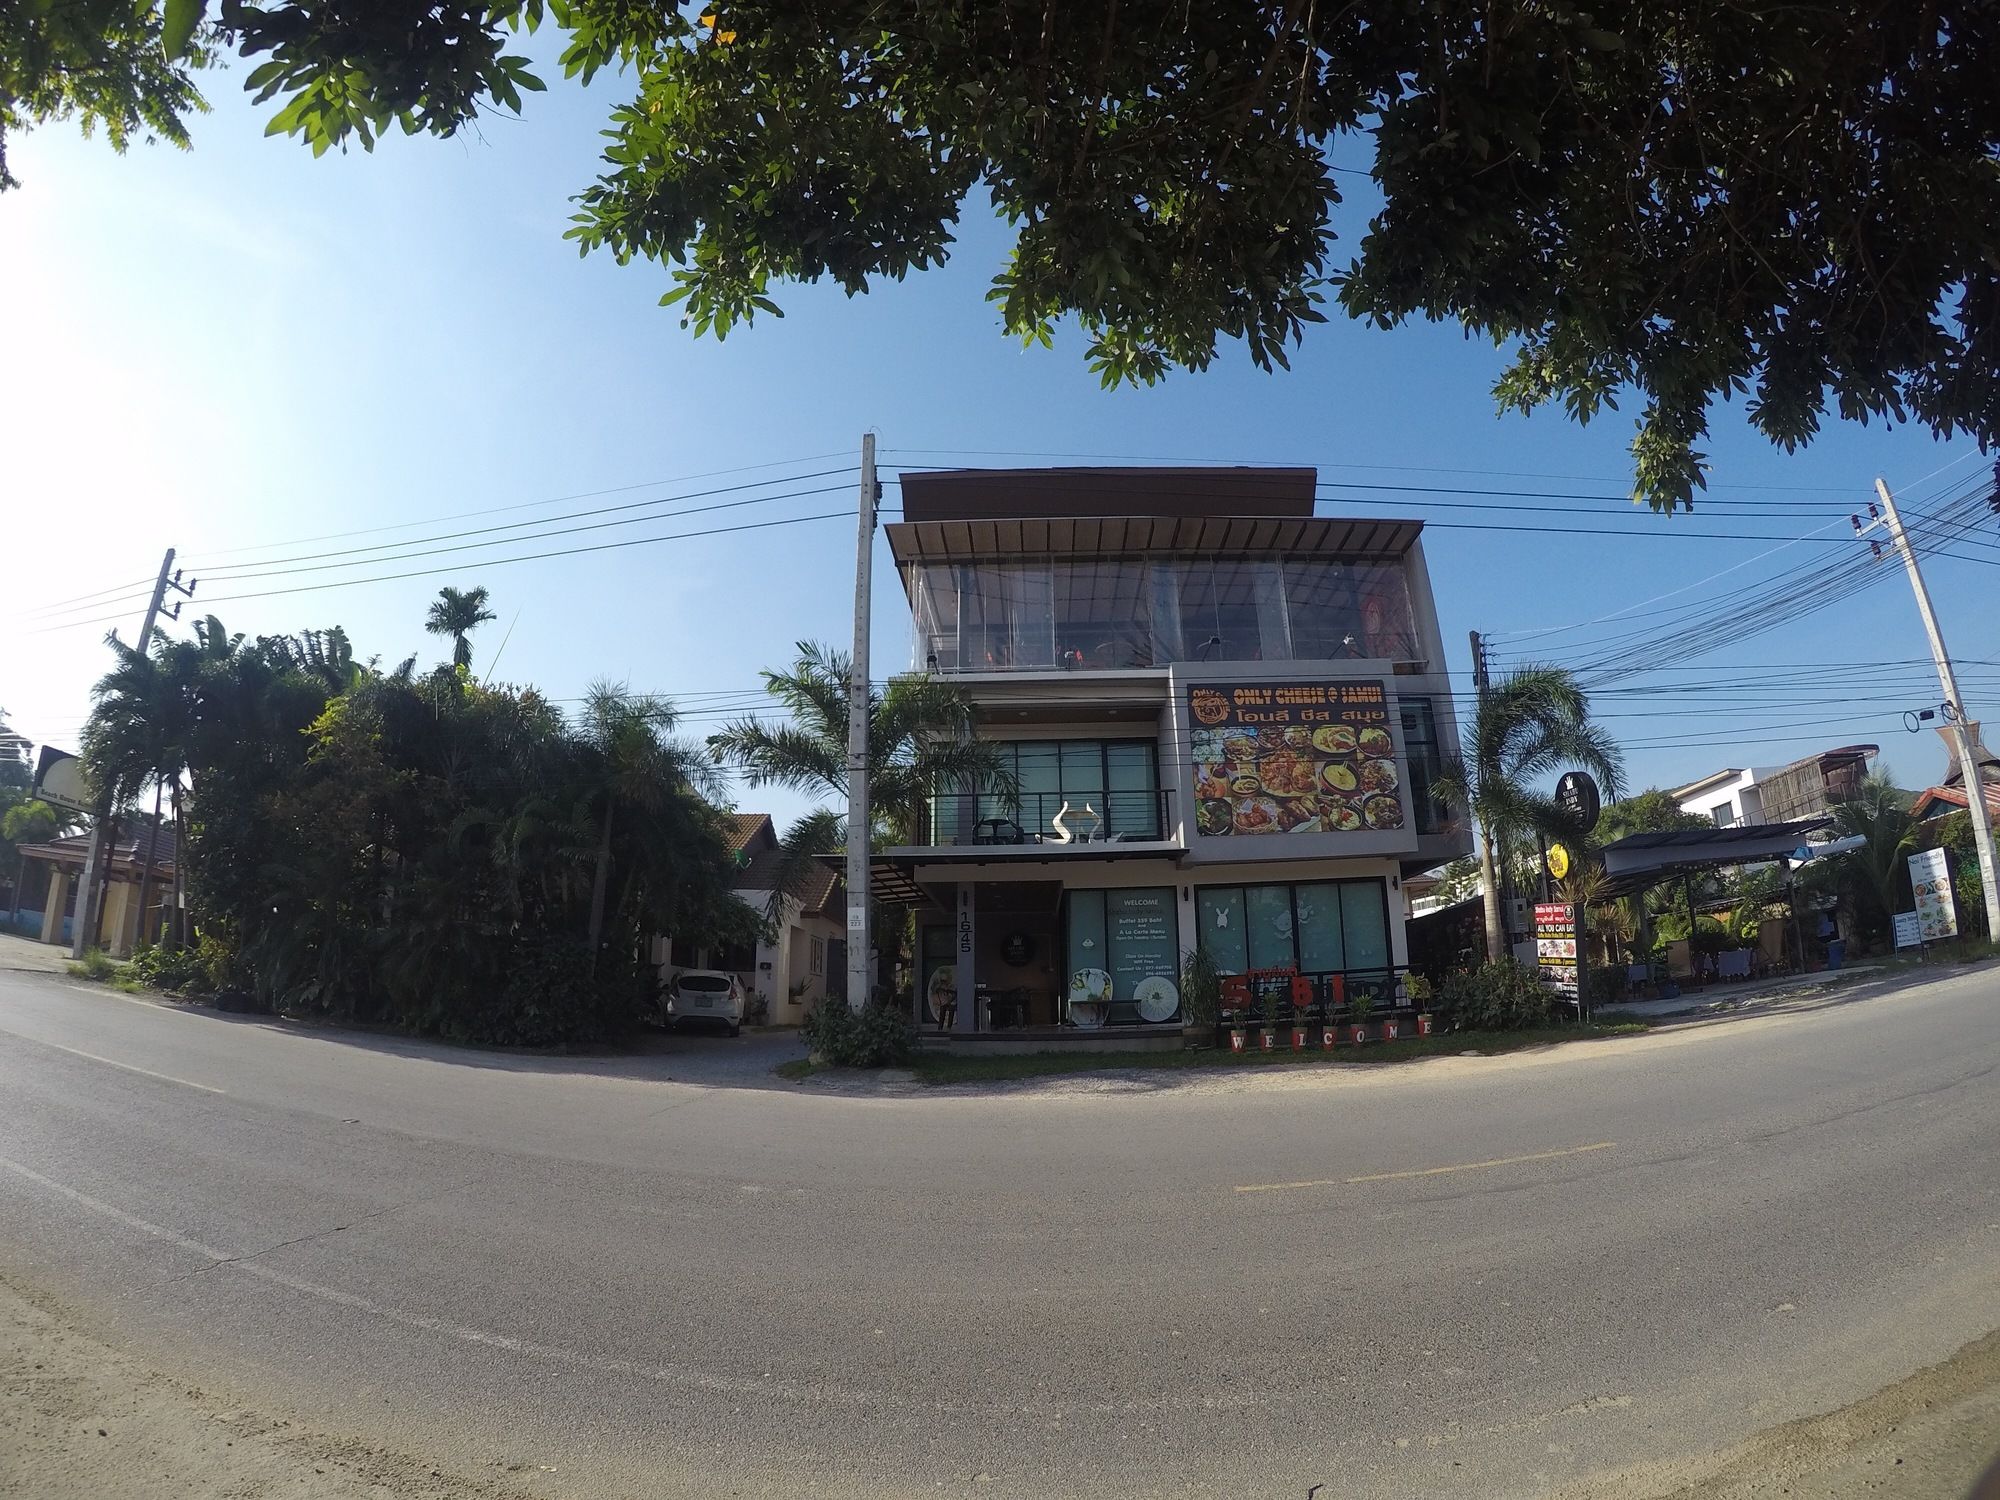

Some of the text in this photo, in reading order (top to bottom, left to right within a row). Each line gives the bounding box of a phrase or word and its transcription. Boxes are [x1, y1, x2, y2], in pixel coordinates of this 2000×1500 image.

[1233, 688, 1272, 705] ONLY
[1275, 687, 1326, 705] CHEESE
[1341, 686, 1382, 703] SAMUI
[1537, 924, 1545, 932] ALL
[1545, 924, 1555, 932] YOU
[1555, 924, 1566, 932] CAN
